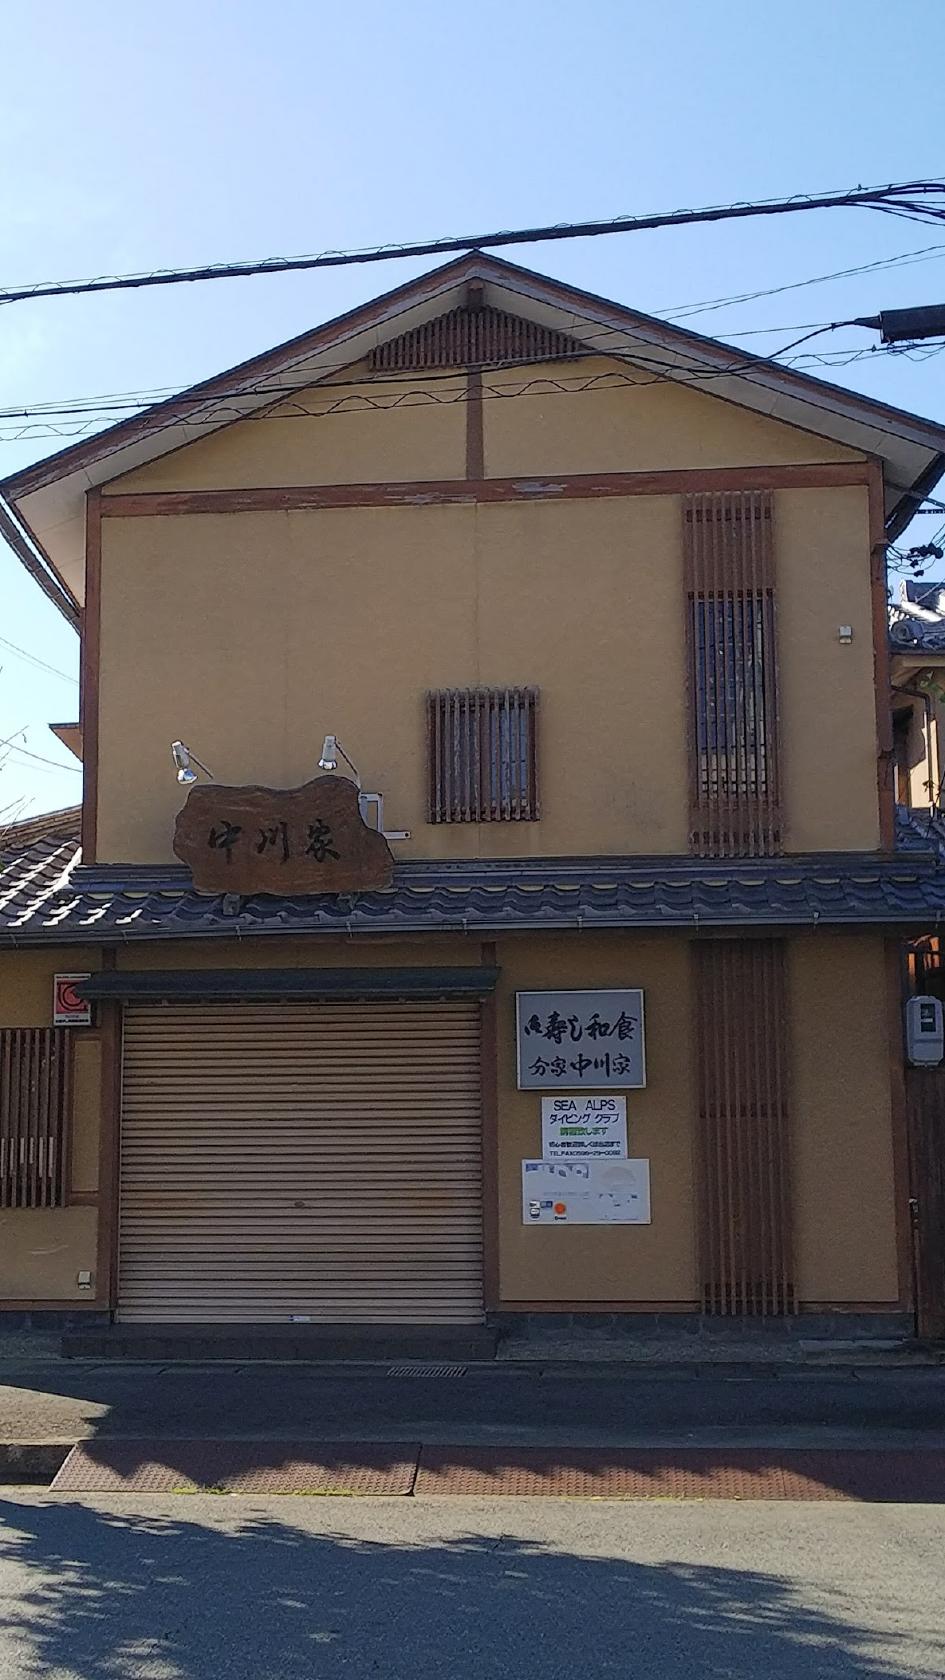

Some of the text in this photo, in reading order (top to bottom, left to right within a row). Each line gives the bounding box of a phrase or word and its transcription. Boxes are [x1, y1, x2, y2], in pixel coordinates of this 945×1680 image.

[207, 818, 340, 865] 中川家
[553, 1099, 616, 1111] SEA ALPS
